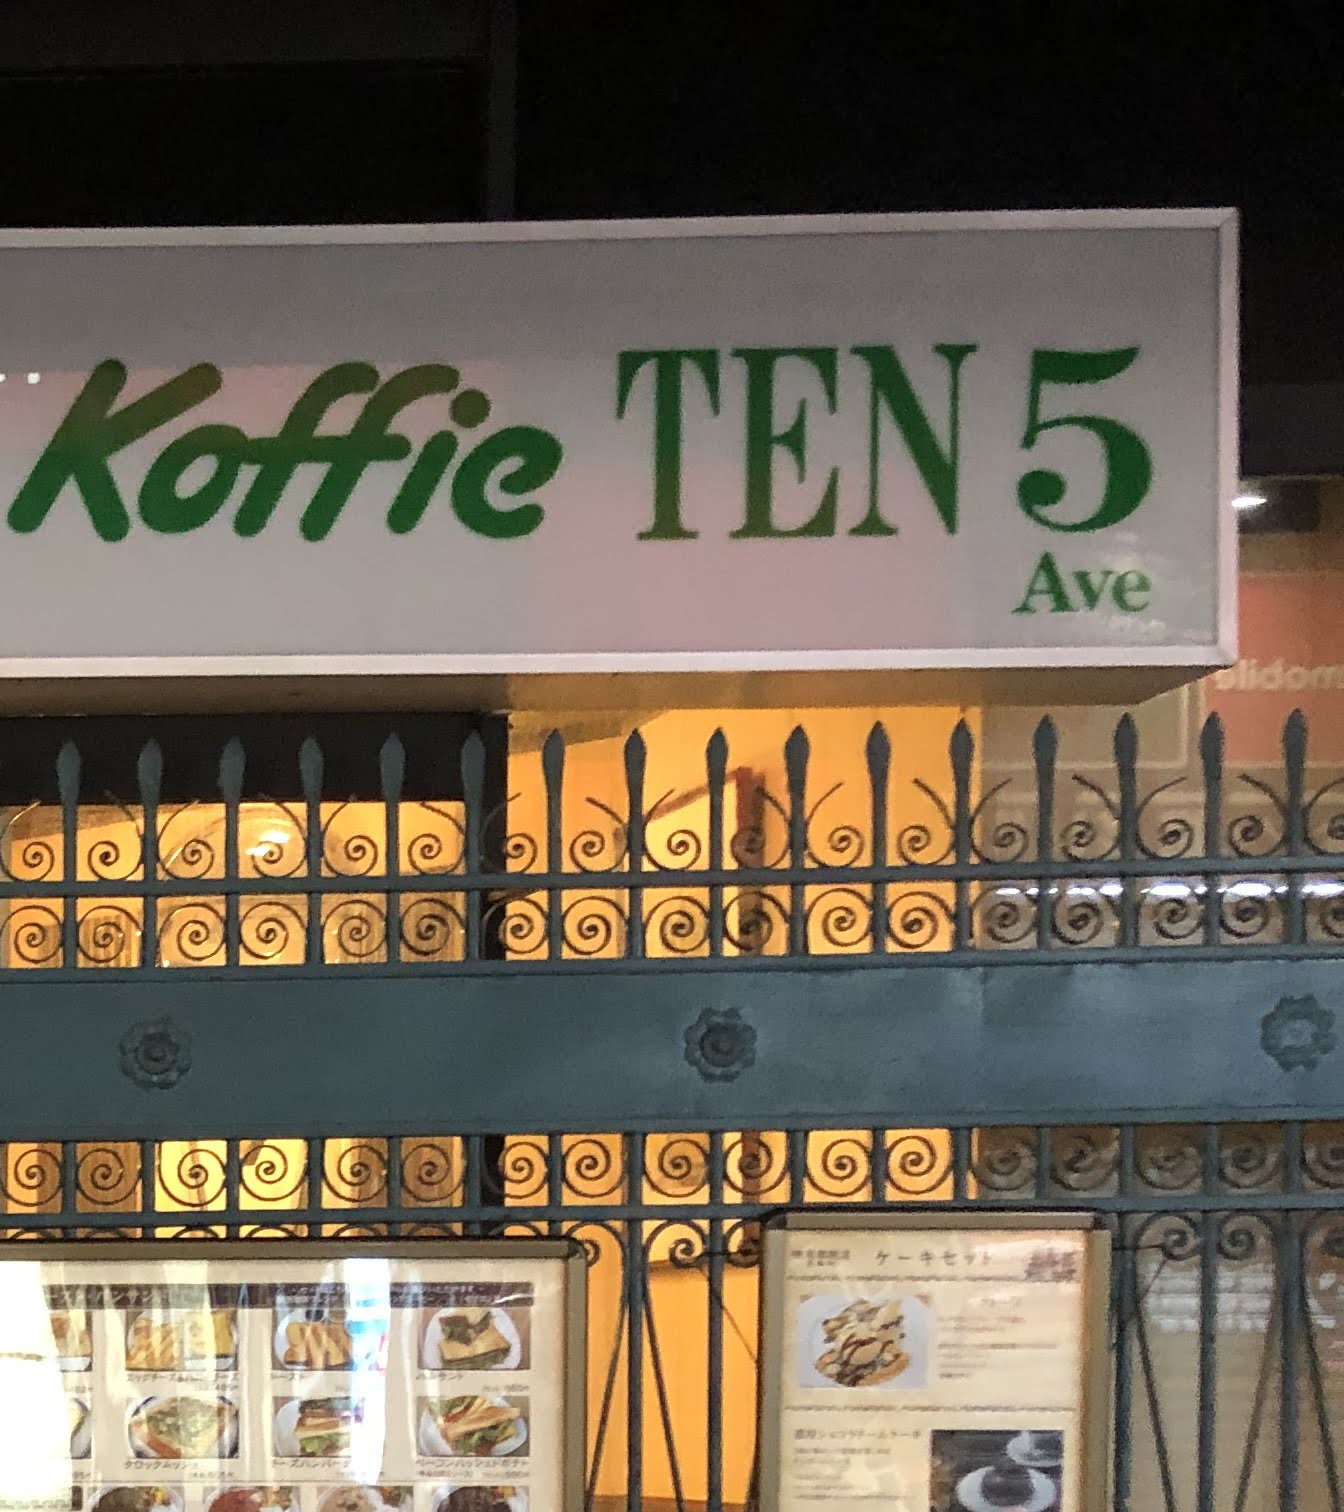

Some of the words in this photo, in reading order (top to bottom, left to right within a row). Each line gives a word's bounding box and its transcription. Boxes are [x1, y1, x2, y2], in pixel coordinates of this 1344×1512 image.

[7, 357, 564, 543] Koffie
[616, 344, 978, 542] TEN
[1015, 345, 1153, 531] 5
[1012, 551, 1152, 613] Ave
